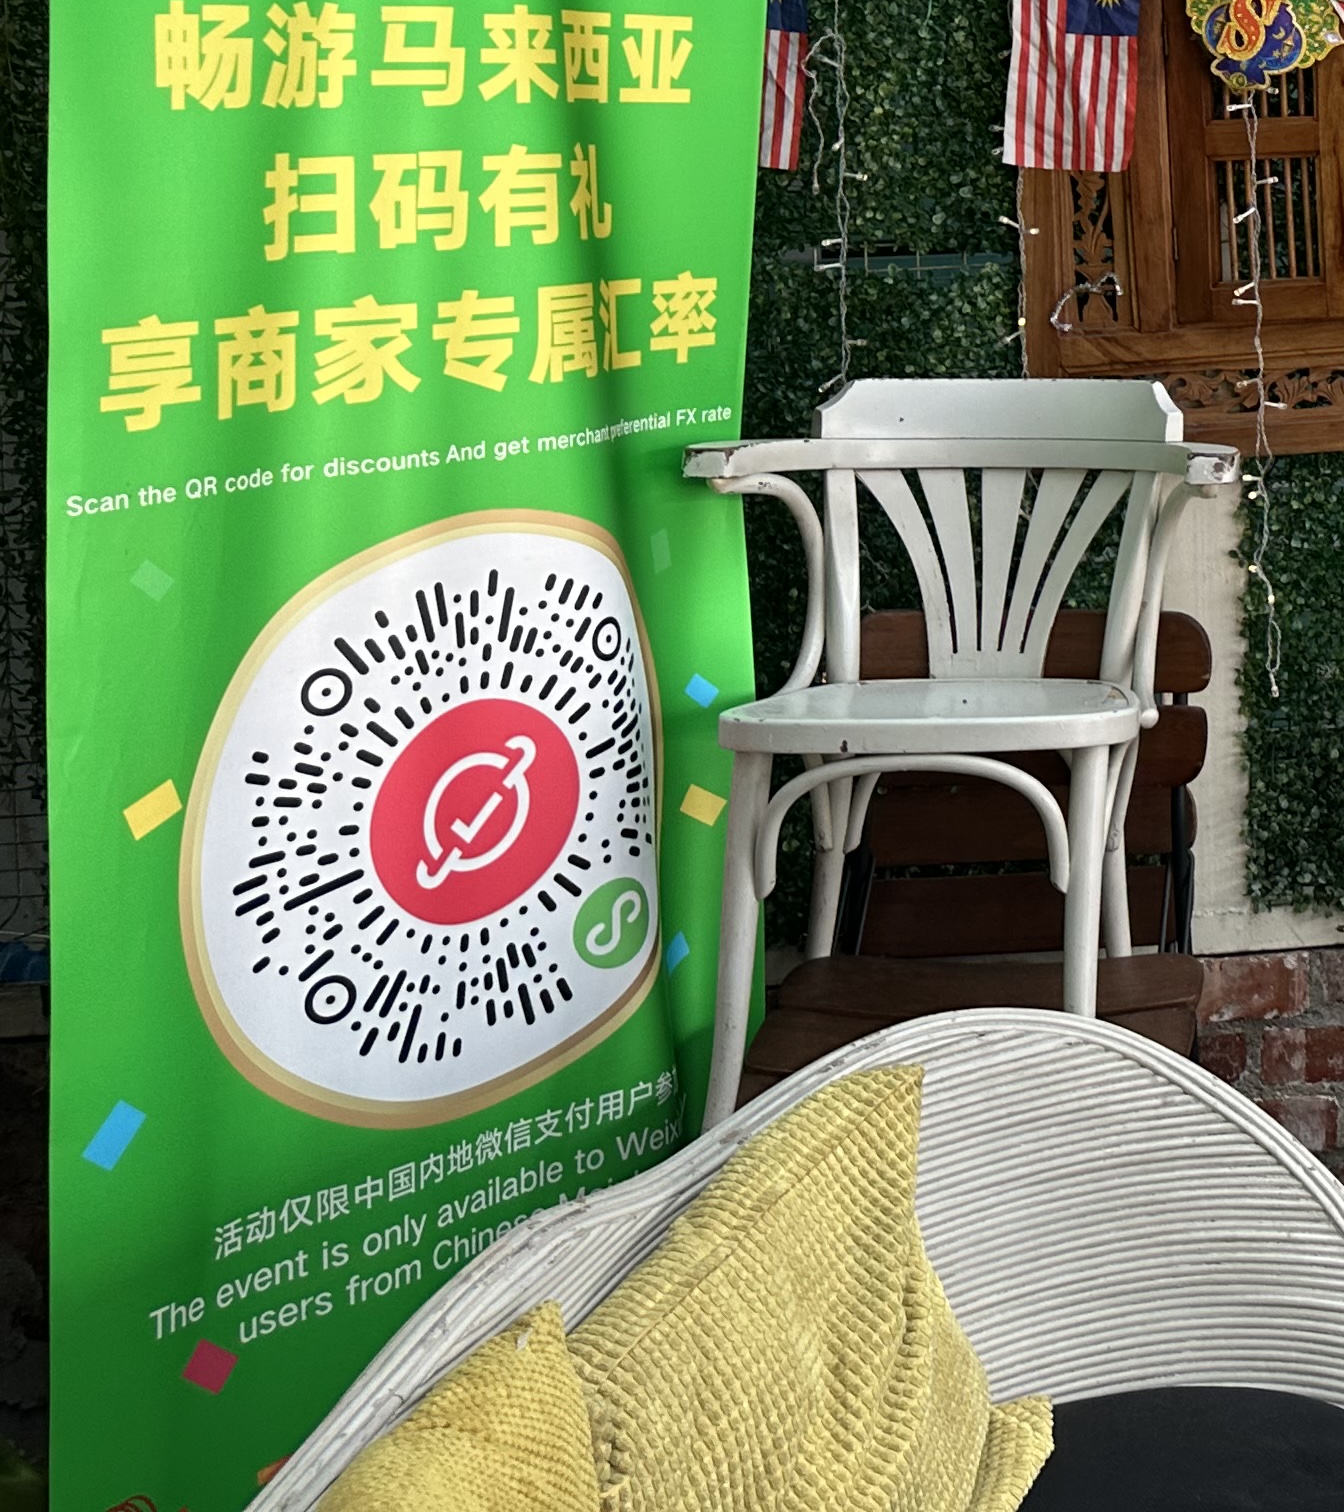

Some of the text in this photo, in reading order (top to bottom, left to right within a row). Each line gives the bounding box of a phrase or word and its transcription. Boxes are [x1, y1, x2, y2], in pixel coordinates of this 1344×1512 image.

[154, 0, 693, 111] 畅游马来西亚
[263, 144, 612, 261] 扫码有礼
[100, 272, 718, 432] 享商家专属汇率
[66, 492, 129, 517] Scan
[138, 484, 177, 507] the
[185, 476, 218, 500] QR
[225, 468, 273, 493] code
[281, 462, 315, 484] for
[323, 448, 440, 478] discounts
[445, 440, 486, 465] And
[494, 437, 530, 462] get
[537, 423, 610, 453] merchant
[676, 407, 697, 427] FX
[701, 404, 733, 424] rate
[213, 1065, 679, 1262] 活动仅限中国内地微信支付用户参
[149, 1296, 205, 1340] The
[216, 1250, 309, 1309] event
[321, 1240, 350, 1271] is
[362, 1213, 428, 1257] only
[437, 1160, 564, 1228] available
[574, 1148, 606, 1175] to
[239, 1291, 334, 1344] users
[345, 1258, 422, 1306] from
